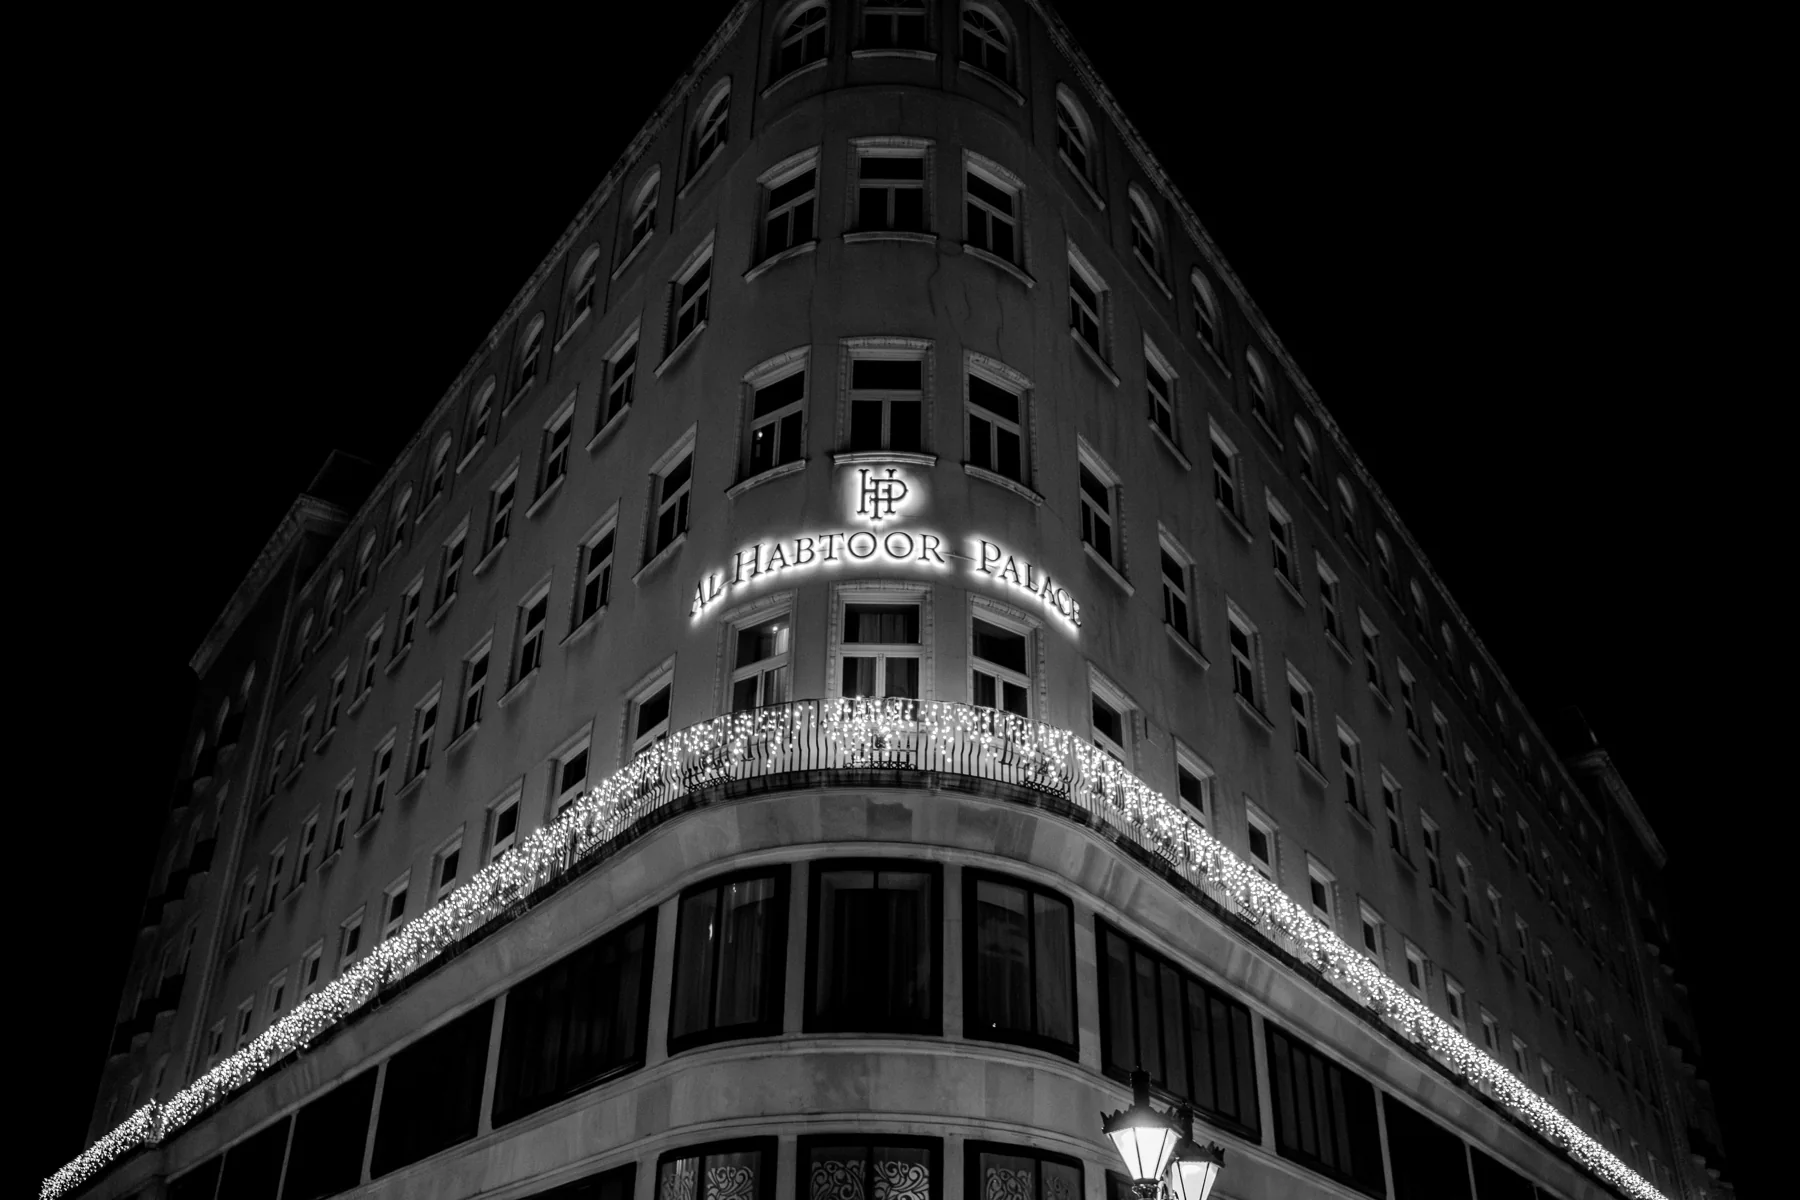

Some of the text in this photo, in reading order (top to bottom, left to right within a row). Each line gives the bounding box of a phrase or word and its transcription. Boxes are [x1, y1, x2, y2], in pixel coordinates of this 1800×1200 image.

[689, 531, 1082, 627] AL HABTOOR PALACE
